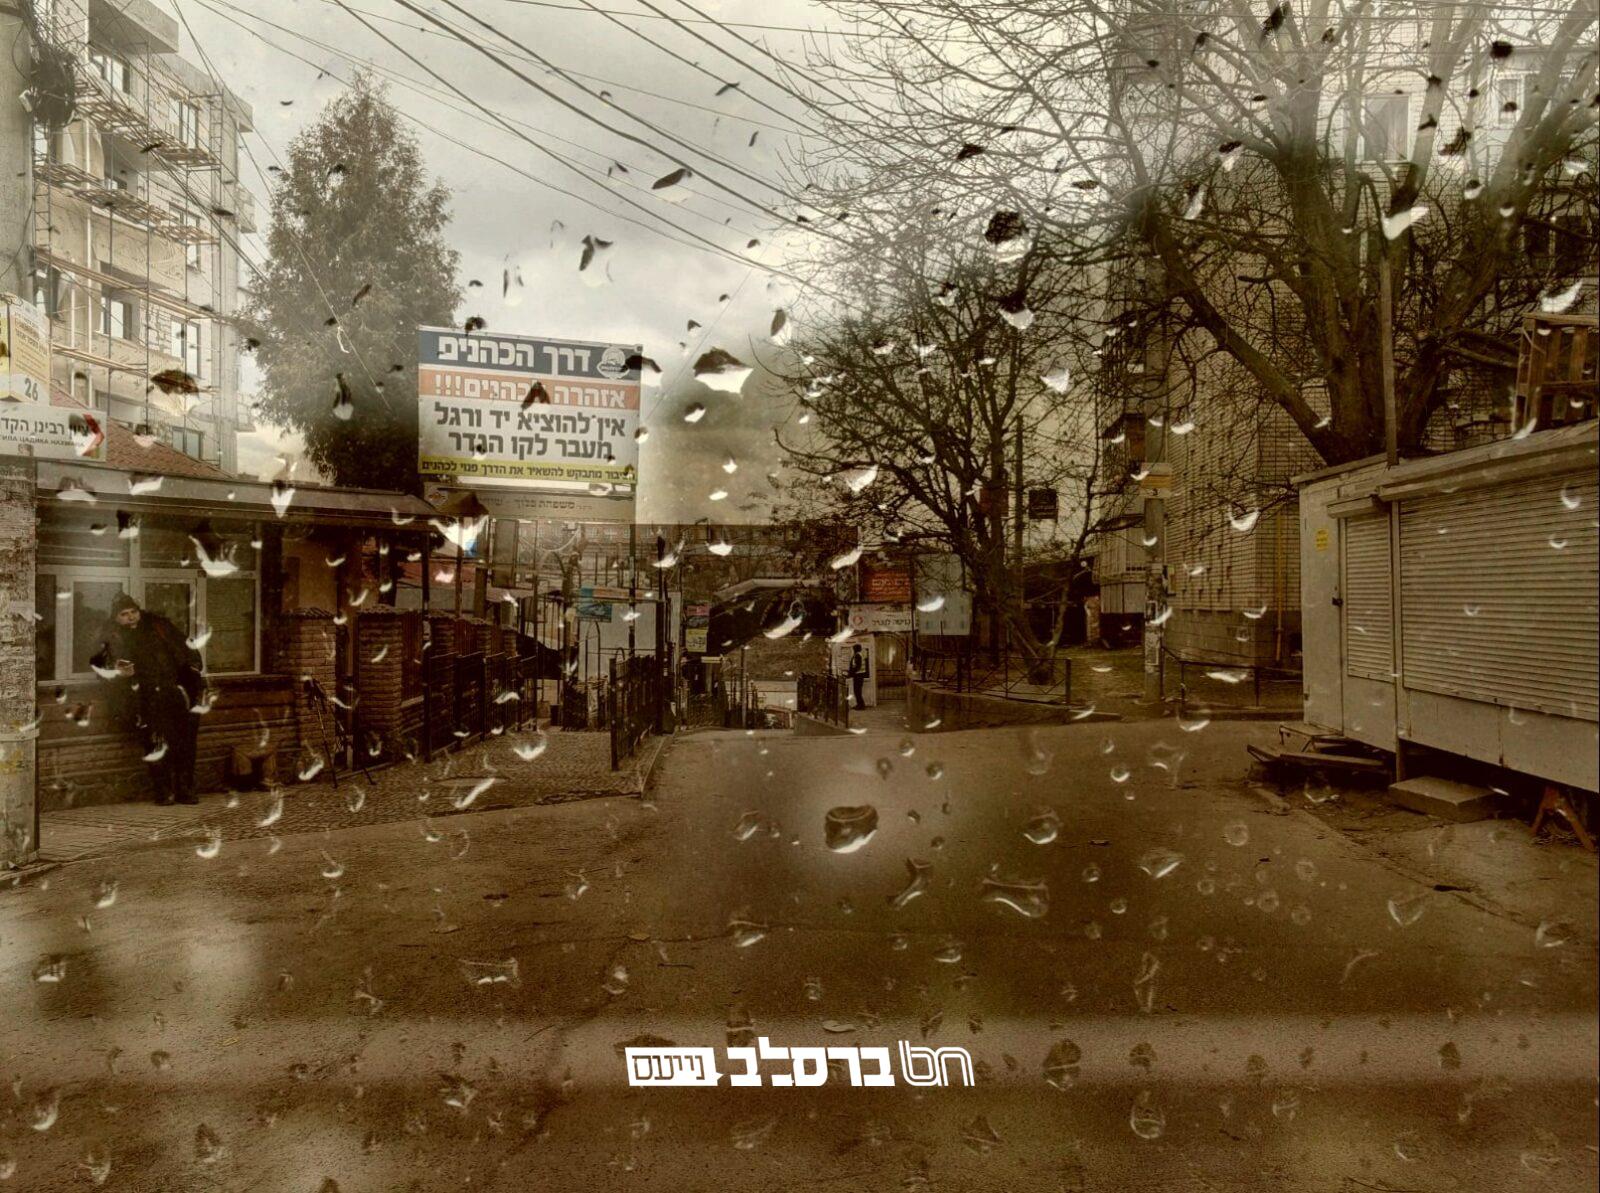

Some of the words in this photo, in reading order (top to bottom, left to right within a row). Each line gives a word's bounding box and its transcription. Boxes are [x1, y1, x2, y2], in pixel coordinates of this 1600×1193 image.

[438, 336, 535, 369] הכהנים
[543, 345, 591, 375] דרך
[24, 377, 39, 402] 26
[435, 374, 547, 402] כהנים!!!
[554, 385, 626, 409] אזהרה
[434, 401, 482, 427] ורגל
[490, 410, 510, 429] יד
[517, 411, 590, 434] להוציא
[34, 420, 65, 435] רבינו
[597, 417, 626, 441] אין
[448, 432, 503, 453] הגדר
[511, 432, 548, 460] לקו
[555, 438, 613, 459] מעבר
[422, 460, 458, 471] לכהנים
[481, 463, 507, 475] הדרך
[509, 465, 524, 475] את
[527, 466, 564, 477] להשאיר
[566, 468, 602, 480] מתבקש
